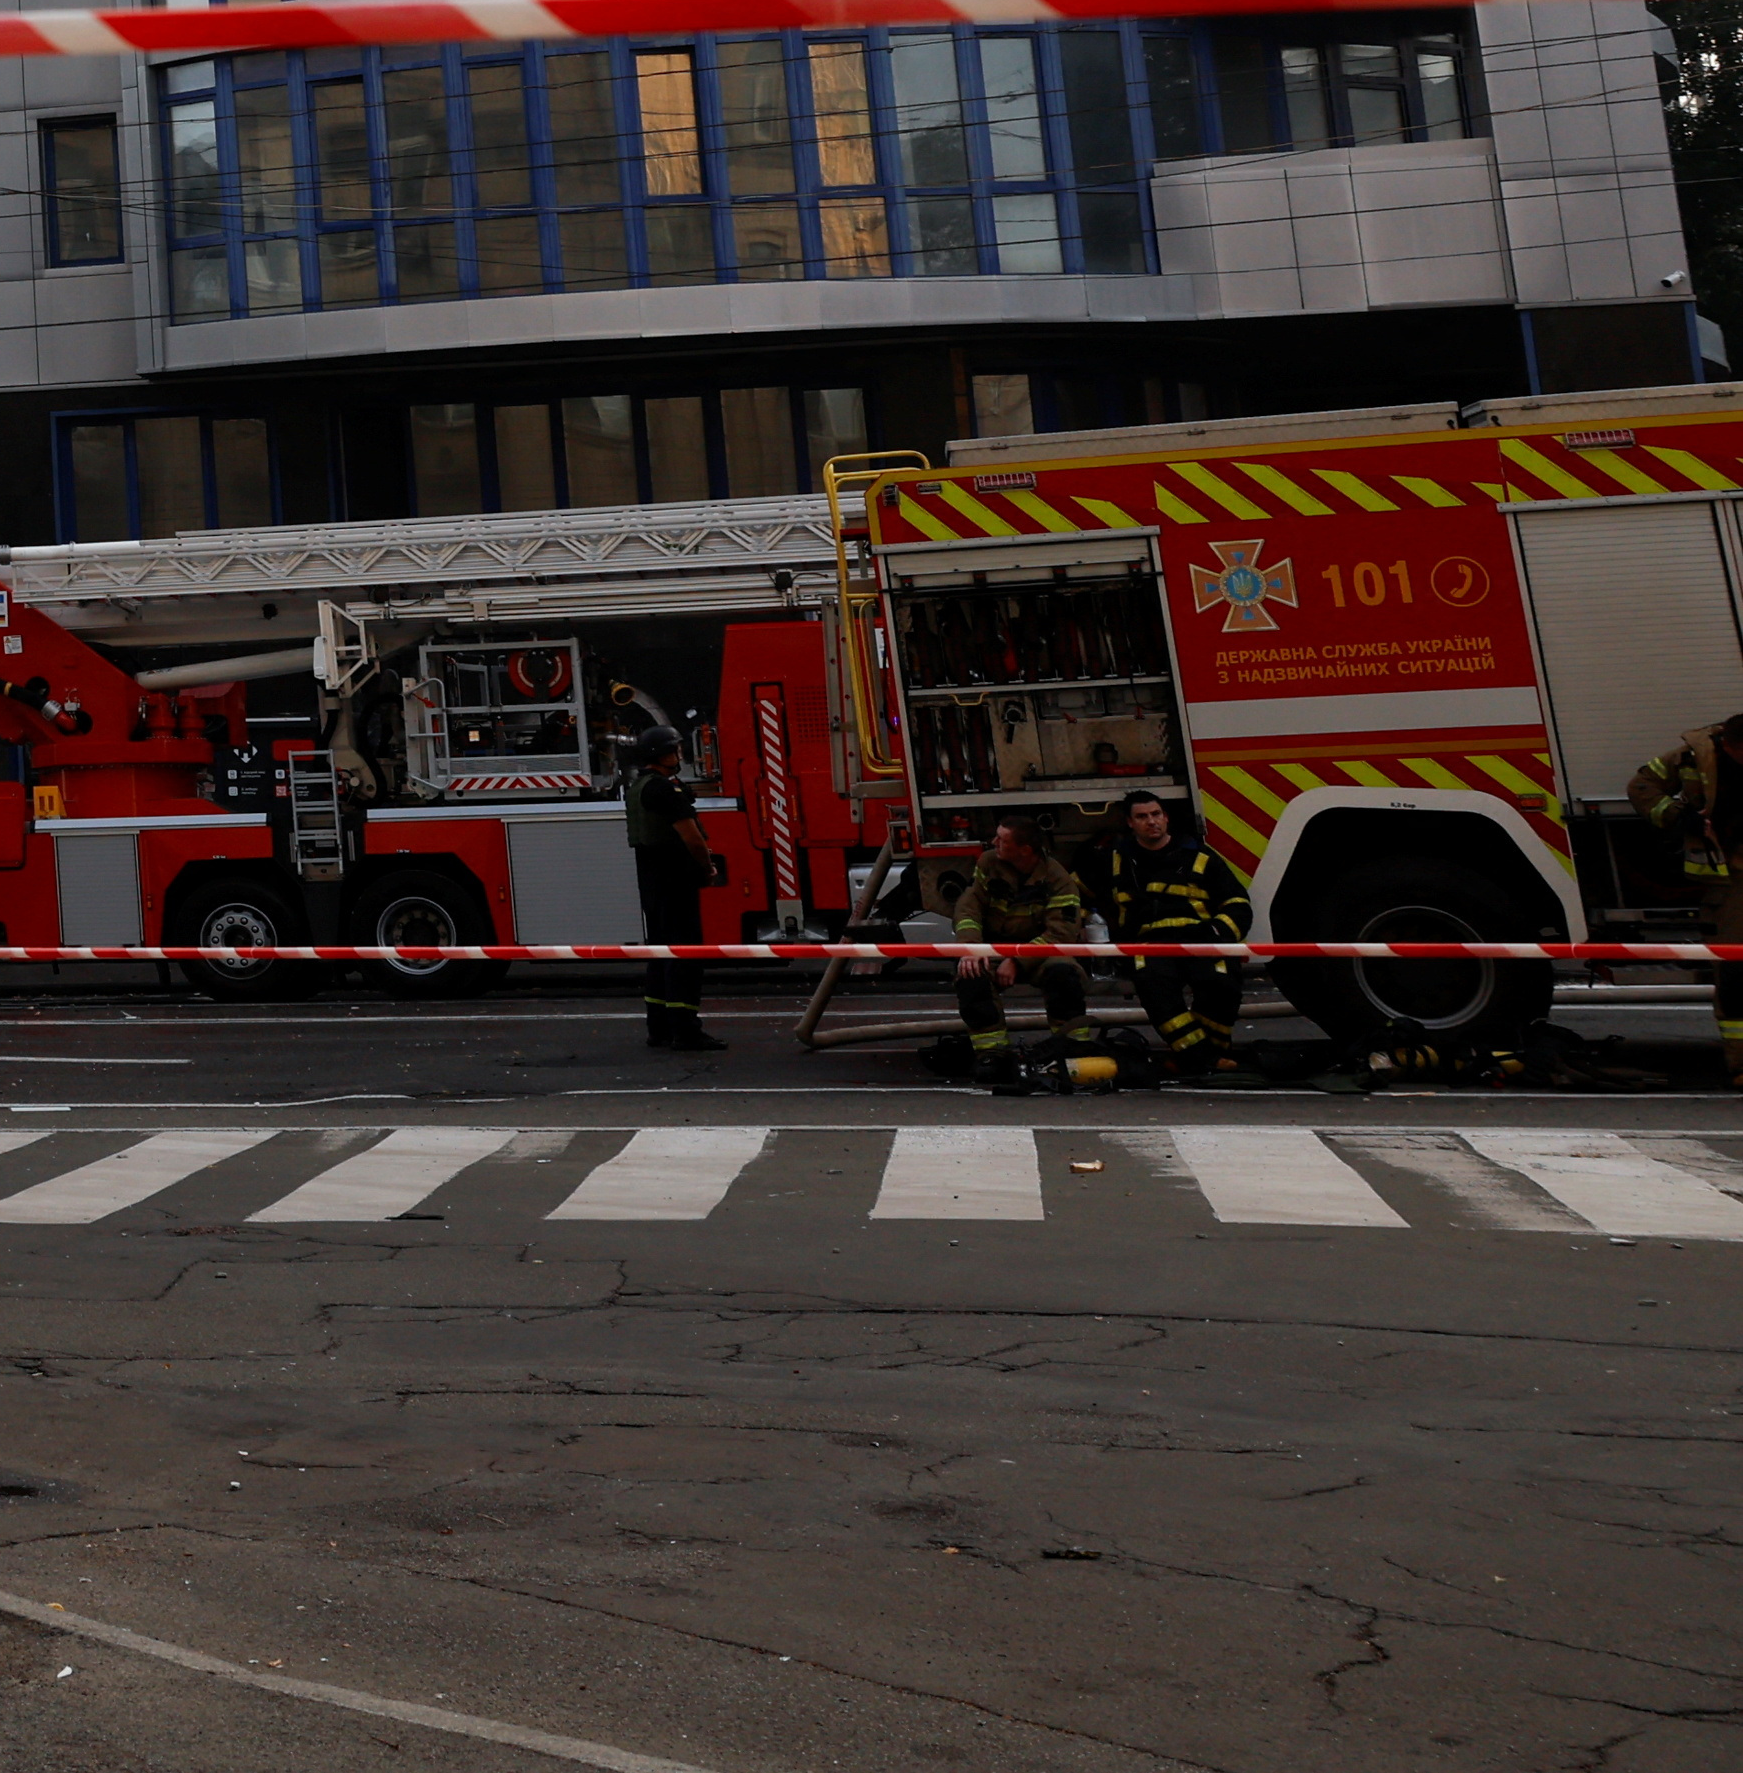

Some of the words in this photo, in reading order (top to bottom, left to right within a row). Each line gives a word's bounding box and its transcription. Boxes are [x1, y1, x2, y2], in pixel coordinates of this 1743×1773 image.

[1321, 560, 1413, 607] 101
[1215, 646, 1318, 667] ДЕРЖАВНА
[1321, 641, 1403, 659] СЛУЖБА
[1405, 635, 1493, 655] УКРАЇНИ
[1217, 671, 1230, 684] З
[1237, 661, 1390, 685] НАДЗВИЧАЙНИХ
[1397, 653, 1496, 674] СИТУАЦІЙ
